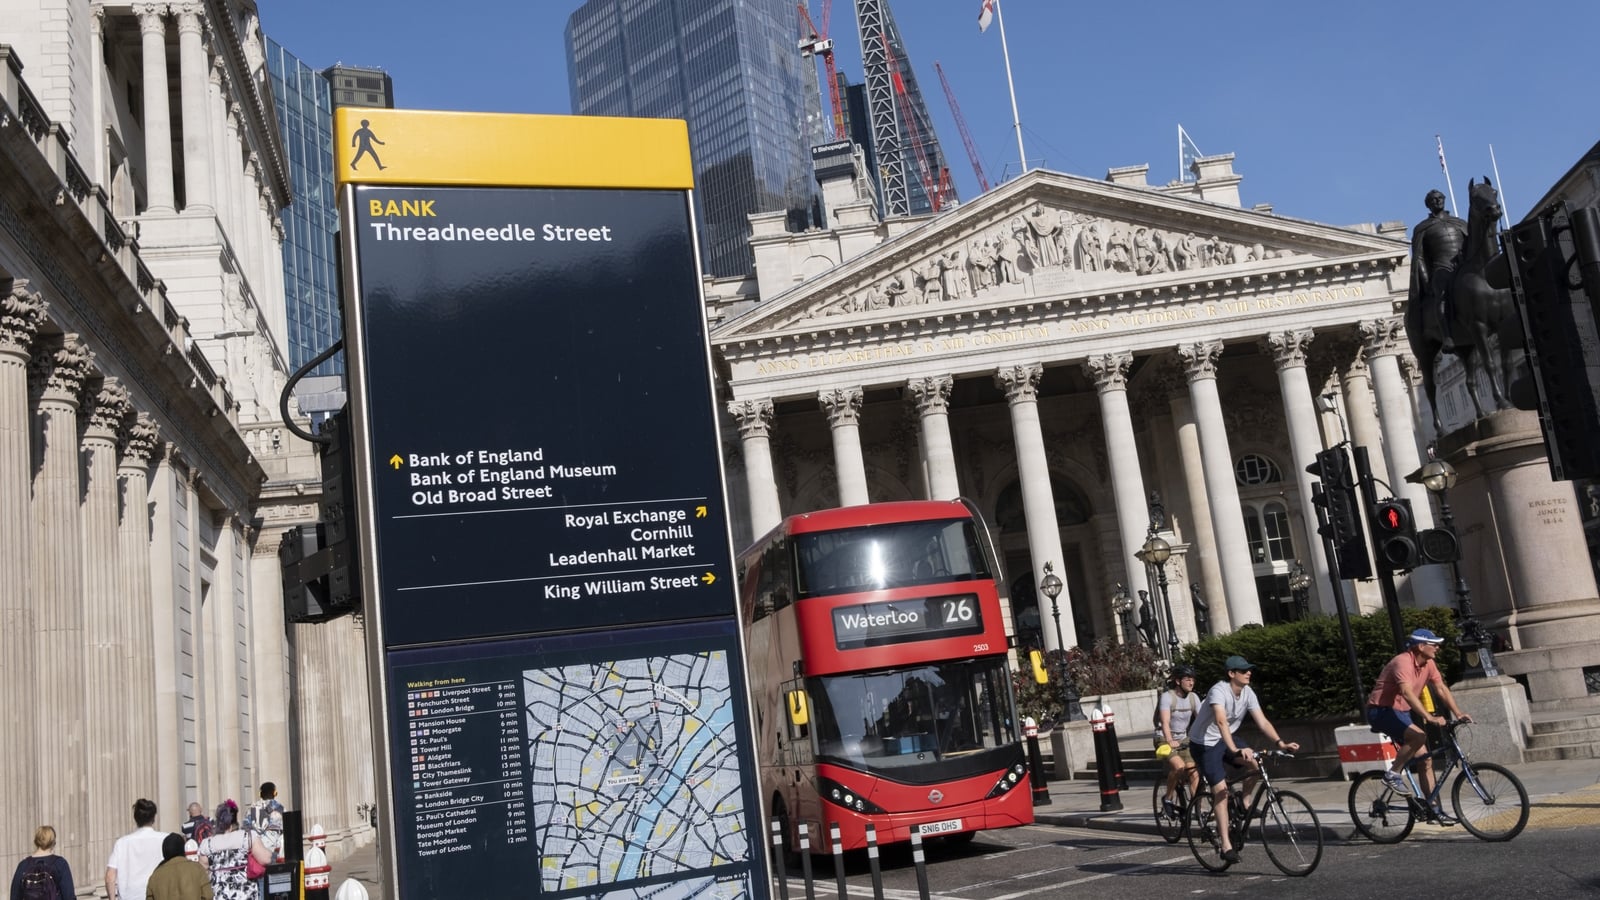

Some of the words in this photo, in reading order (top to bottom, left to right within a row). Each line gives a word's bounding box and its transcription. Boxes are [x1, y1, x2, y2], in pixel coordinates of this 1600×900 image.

[818, 142, 849, 152] Bishopsgate
[369, 200, 437, 216] BANK
[371, 223, 536, 241] Threadneedle
[542, 224, 612, 241] Street
[758, 359, 799, 375] ANNO
[809, 344, 913, 368] ELIZABETHAE
[972, 327, 1049, 346] CONDITVM
[1070, 318, 1110, 334] ANNO
[1120, 307, 1196, 326] VICTORIAE
[1224, 300, 1248, 313] VIII
[1256, 286, 1364, 309] RESTAVRATVM
[409, 454, 450, 467] Bank
[456, 451, 474, 464] of
[478, 448, 543, 466] England
[411, 472, 452, 486] Bank
[457, 470, 475, 484] of
[480, 467, 545, 484] England
[550, 463, 617, 479] Museum
[412, 490, 443, 505] Old
[449, 488, 497, 503] Broad
[502, 485, 552, 500] Street
[1528, 499, 1567, 508] ERECTED
[565, 512, 609, 528] Royal
[614, 509, 686, 526] Exchange
[631, 526, 693, 542] Cornhill
[550, 548, 637, 567] Leadenhall
[641, 544, 695, 560] Market
[544, 584, 580, 600] King
[585, 579, 646, 596] William
[650, 574, 698, 591] Street
[841, 611, 918, 629] Waterloo
[944, 599, 972, 623] 26
[973, 643, 989, 652] 2503
[432, 727, 462, 735] Moorgate
[428, 761, 461, 769] Blackfriars
[436, 768, 472, 777] Thameslink
[424, 791, 453, 799] Bankside
[446, 808, 476, 817] Cathedral
[416, 822, 444, 830] Museum
[922, 824, 939, 833] SN16
[942, 821, 957, 830] OHS
[417, 831, 443, 839] Borough
[433, 838, 457, 846] Modern
